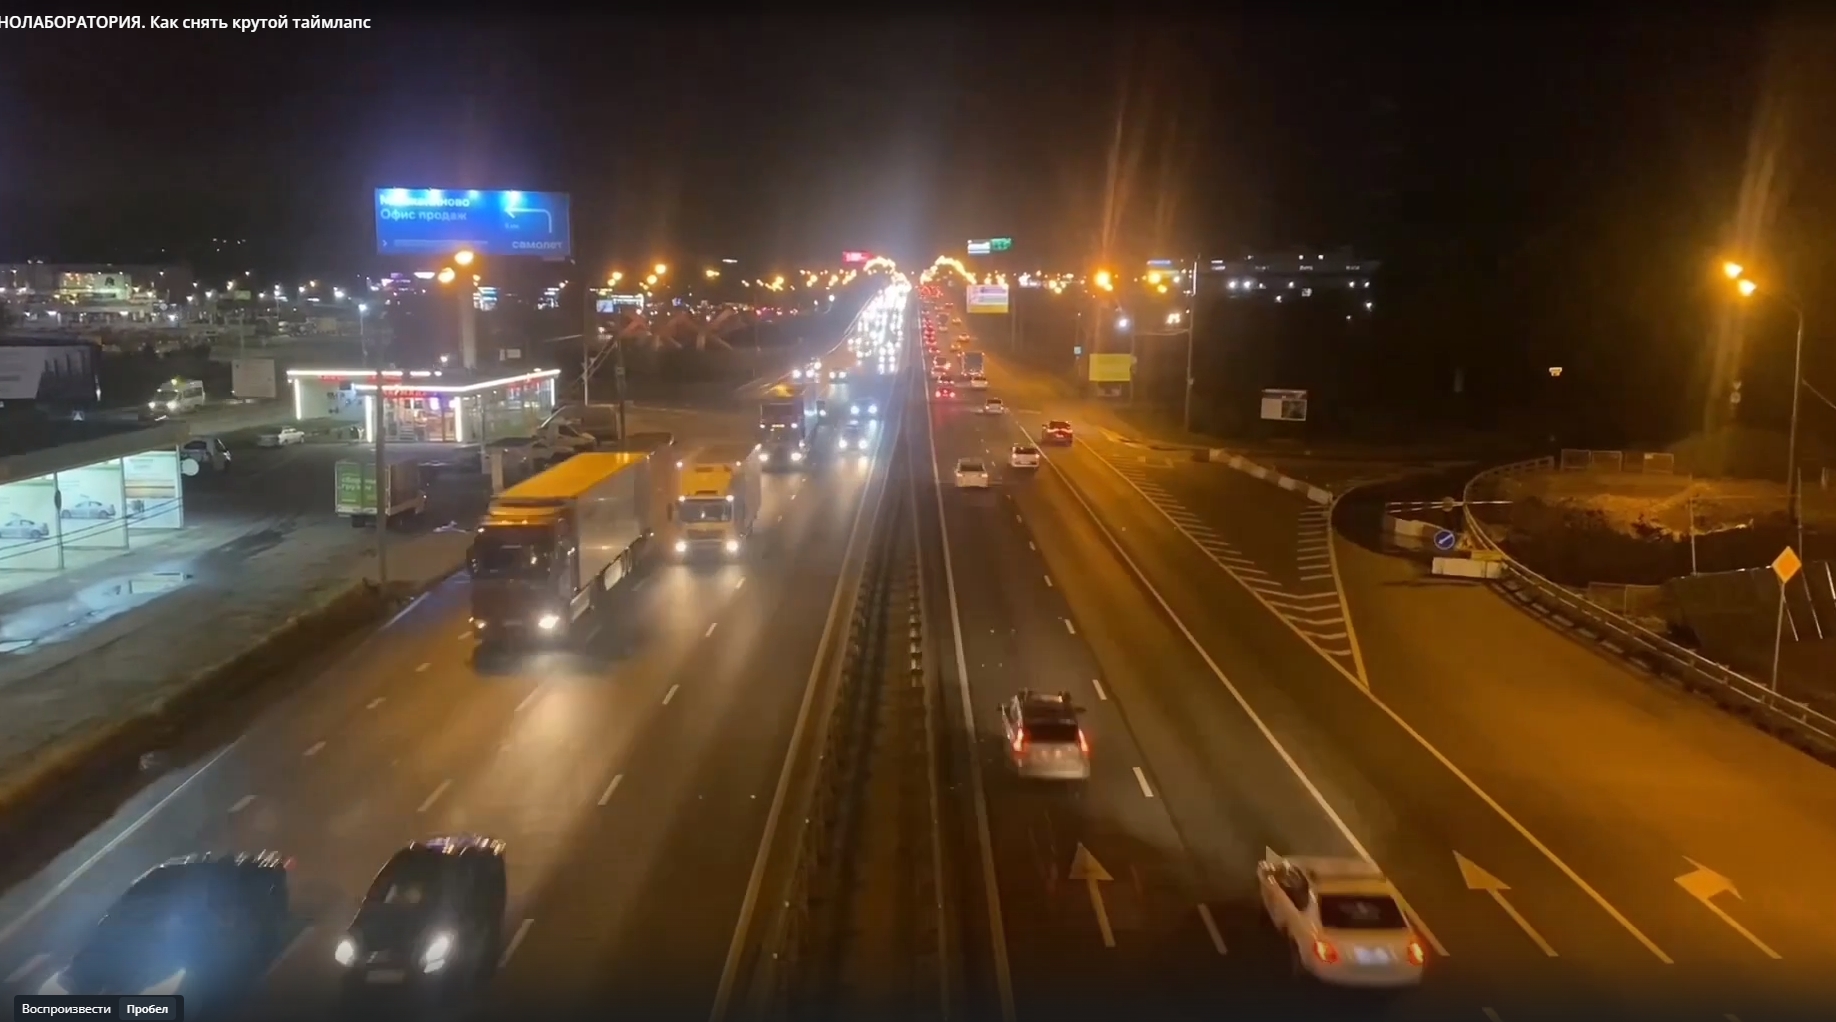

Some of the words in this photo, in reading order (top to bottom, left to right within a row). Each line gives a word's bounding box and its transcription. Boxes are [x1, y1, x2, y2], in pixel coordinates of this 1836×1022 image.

[380, 208, 416, 222] Офис
[418, 211, 468, 222] продаж
[511, 240, 563, 250] самолет
